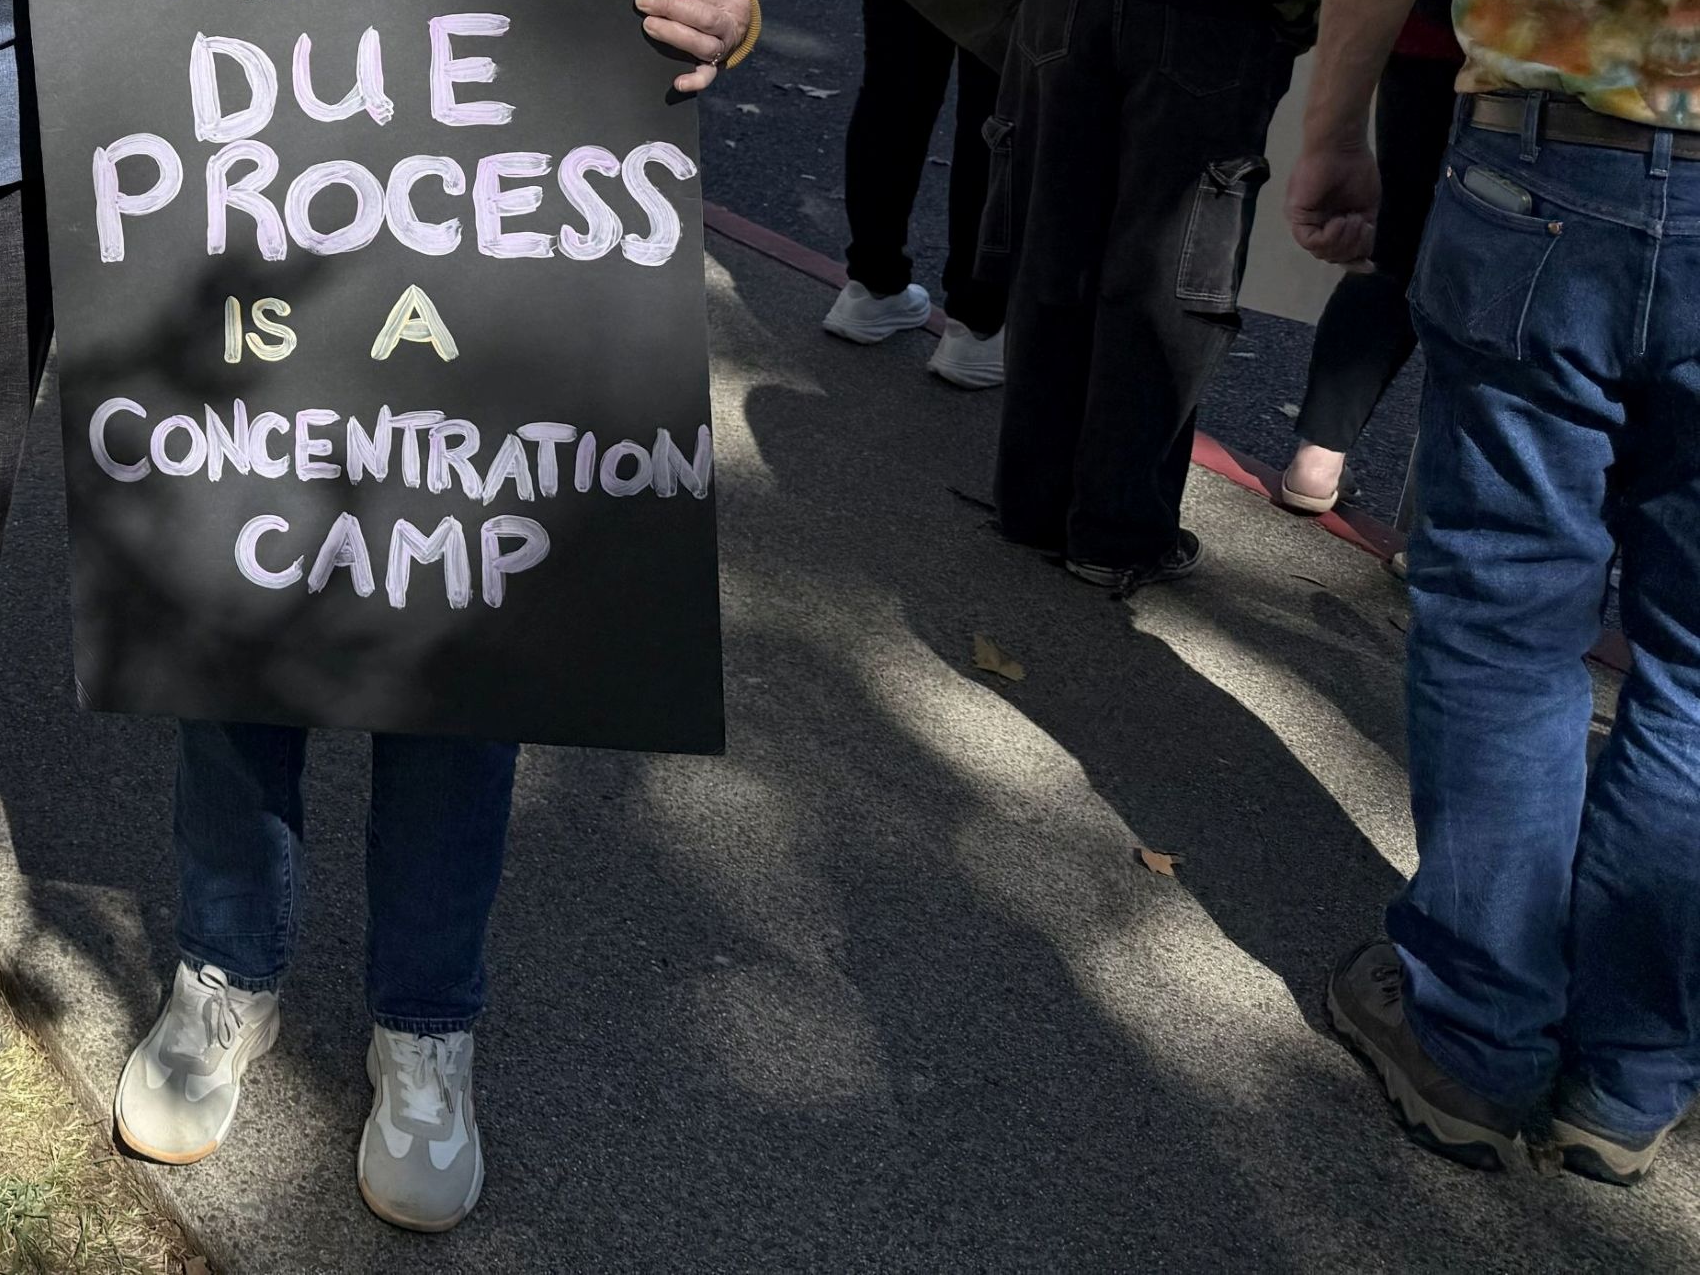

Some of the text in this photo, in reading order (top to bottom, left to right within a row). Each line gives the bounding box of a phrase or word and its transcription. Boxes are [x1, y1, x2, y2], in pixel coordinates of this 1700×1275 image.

[188, 11, 517, 144] DUE
[92, 131, 698, 268] PROCESS
[223, 284, 460, 365] IS A
[88, 396, 714, 506] CONCENTRATION
[233, 511, 551, 610] CAMP
